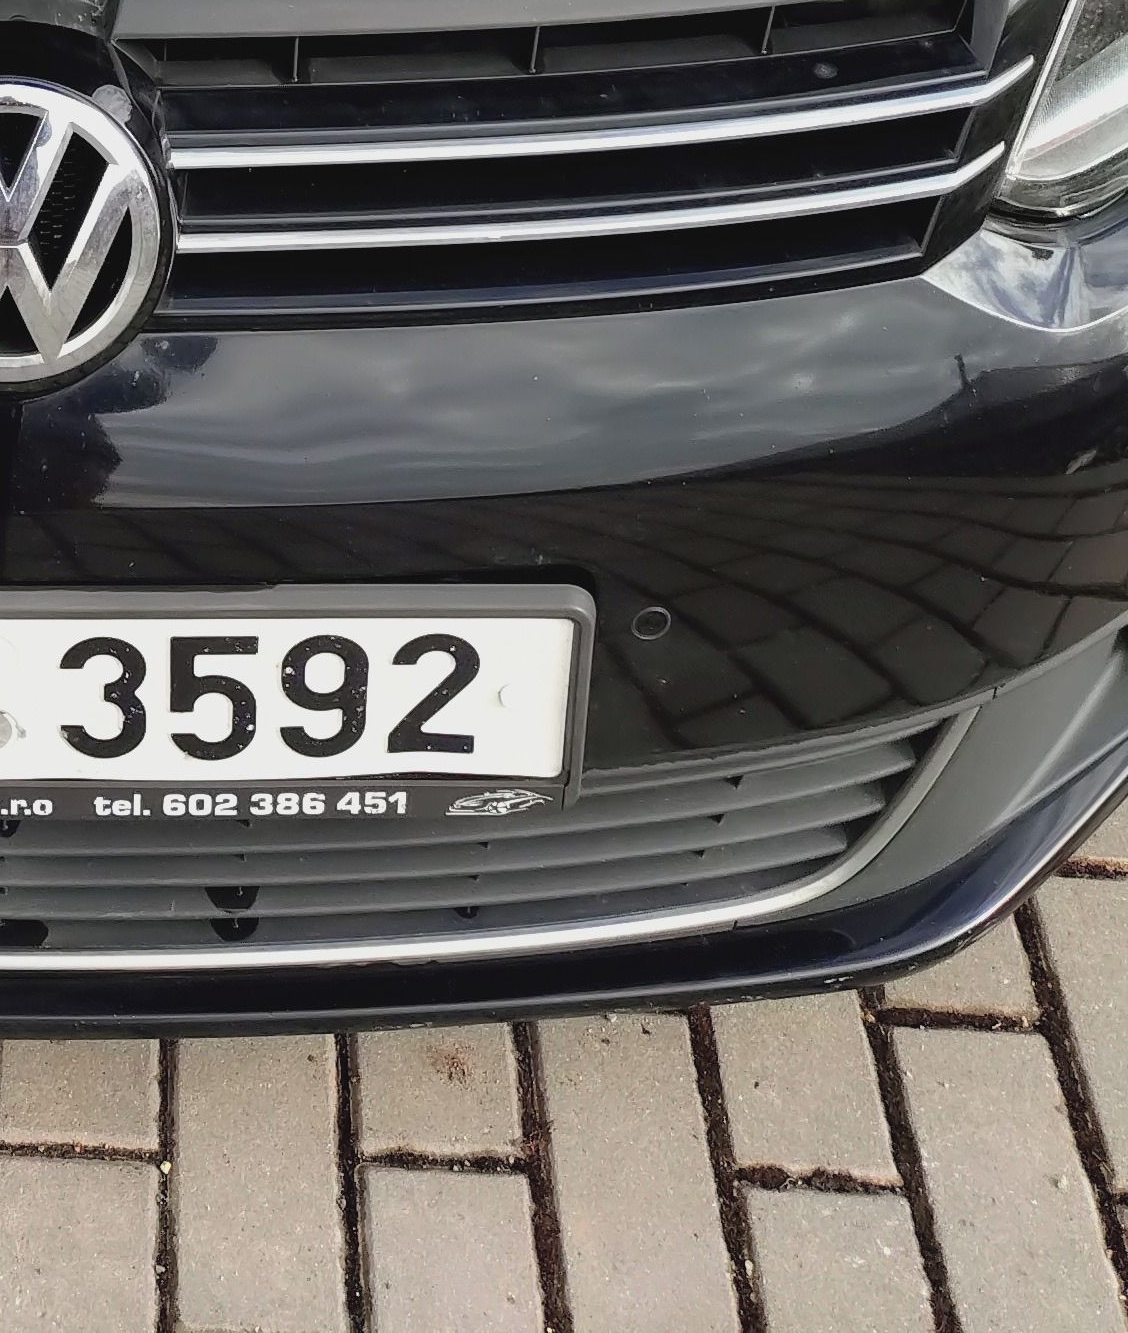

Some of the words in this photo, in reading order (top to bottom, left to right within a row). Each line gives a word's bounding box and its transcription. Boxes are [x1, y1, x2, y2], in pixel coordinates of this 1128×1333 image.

[59, 632, 481, 761] 3592
[93, 792, 152, 816] tel.
[162, 793, 239, 817] 602
[249, 792, 326, 815] 386
[336, 790, 409, 815] 451
